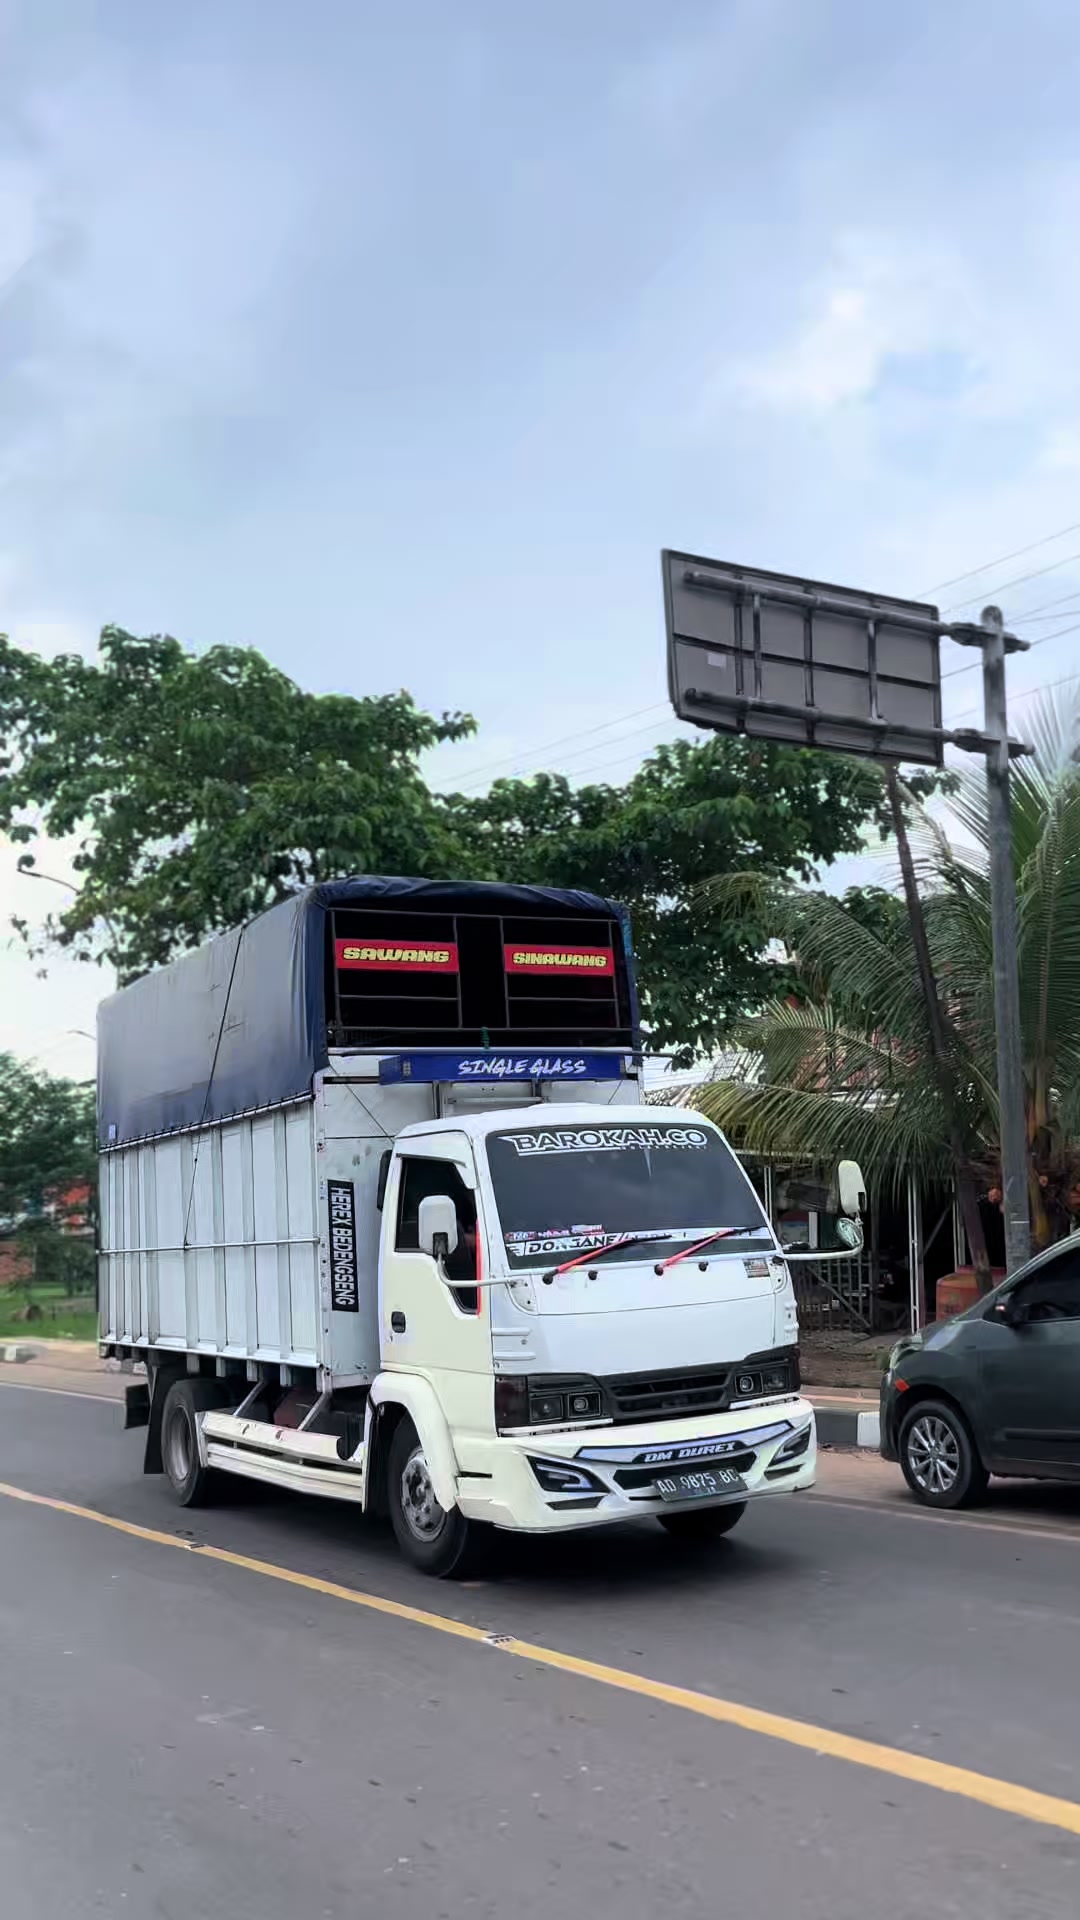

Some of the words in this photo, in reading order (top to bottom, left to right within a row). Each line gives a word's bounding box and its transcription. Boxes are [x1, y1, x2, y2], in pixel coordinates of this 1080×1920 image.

[342, 946, 451, 964] SAWANG
[512, 951, 608, 968] SINAWANG
[457, 1057, 527, 1078] SINGLE
[529, 1057, 588, 1077] GLASS
[514, 1128, 708, 1152] BAROKAH.CO
[330, 1186, 353, 1226] HEREX
[678, 1441, 737, 1459] DUREX
[656, 1478, 677, 1494] AD
[680, 1471, 717, 1490] 9875
[718, 1468, 740, 1484] BC
